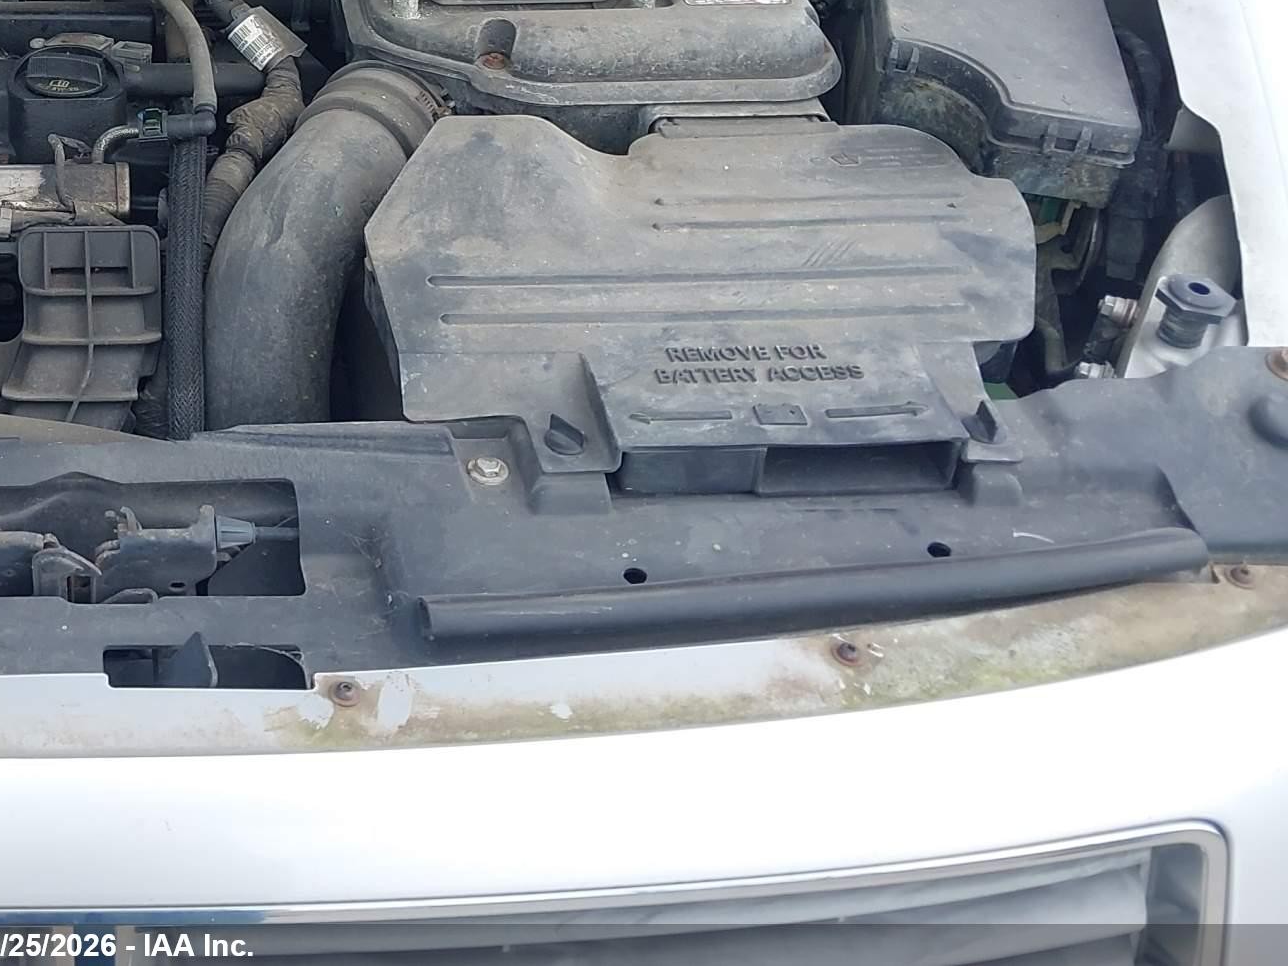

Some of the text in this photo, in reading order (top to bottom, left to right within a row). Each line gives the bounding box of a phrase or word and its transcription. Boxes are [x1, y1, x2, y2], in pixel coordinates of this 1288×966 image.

[665, 344, 827, 362] REMOVE FOR
[654, 364, 864, 384] BATTERY ACCESS
